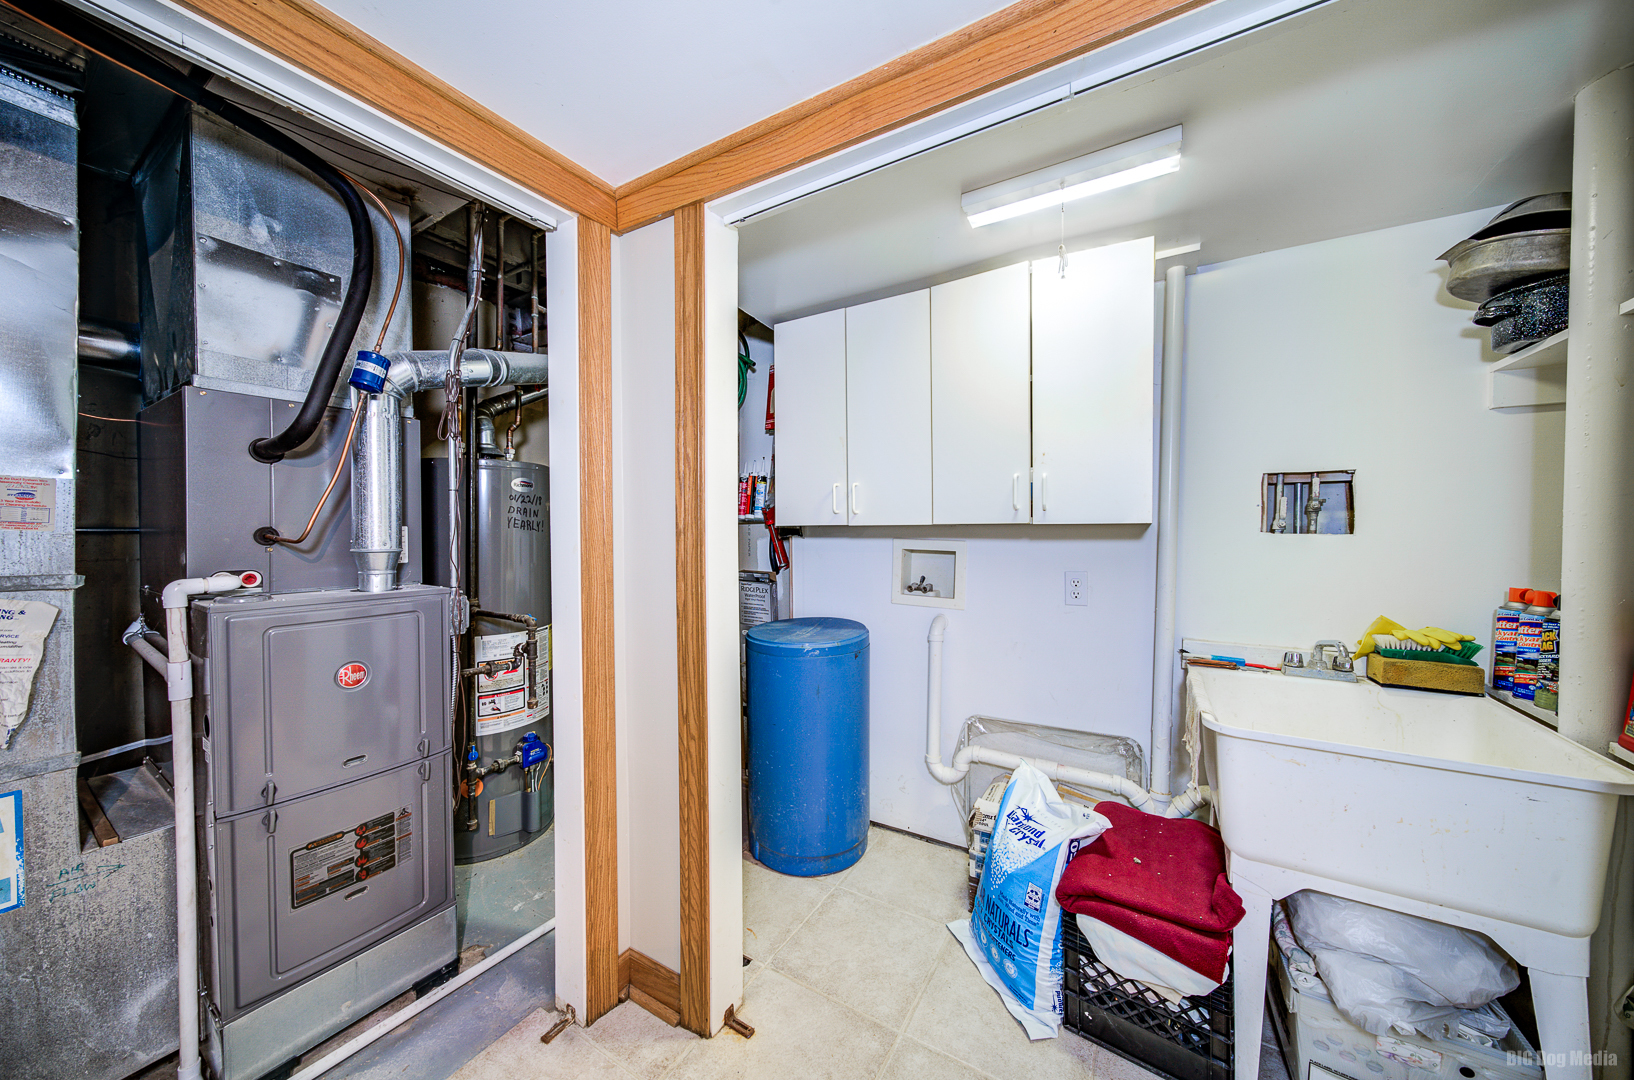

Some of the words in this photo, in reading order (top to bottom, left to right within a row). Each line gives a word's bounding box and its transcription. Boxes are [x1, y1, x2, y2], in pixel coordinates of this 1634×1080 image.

[507, 505, 539, 518] DRAIN
[507, 516, 544, 532] YEARLY!
[342, 666, 366, 685] Rheem
[58, 862, 85, 880] AIR
[985, 894, 1031, 948] NATURALS
[984, 913, 1014, 949] CRYSTALS
